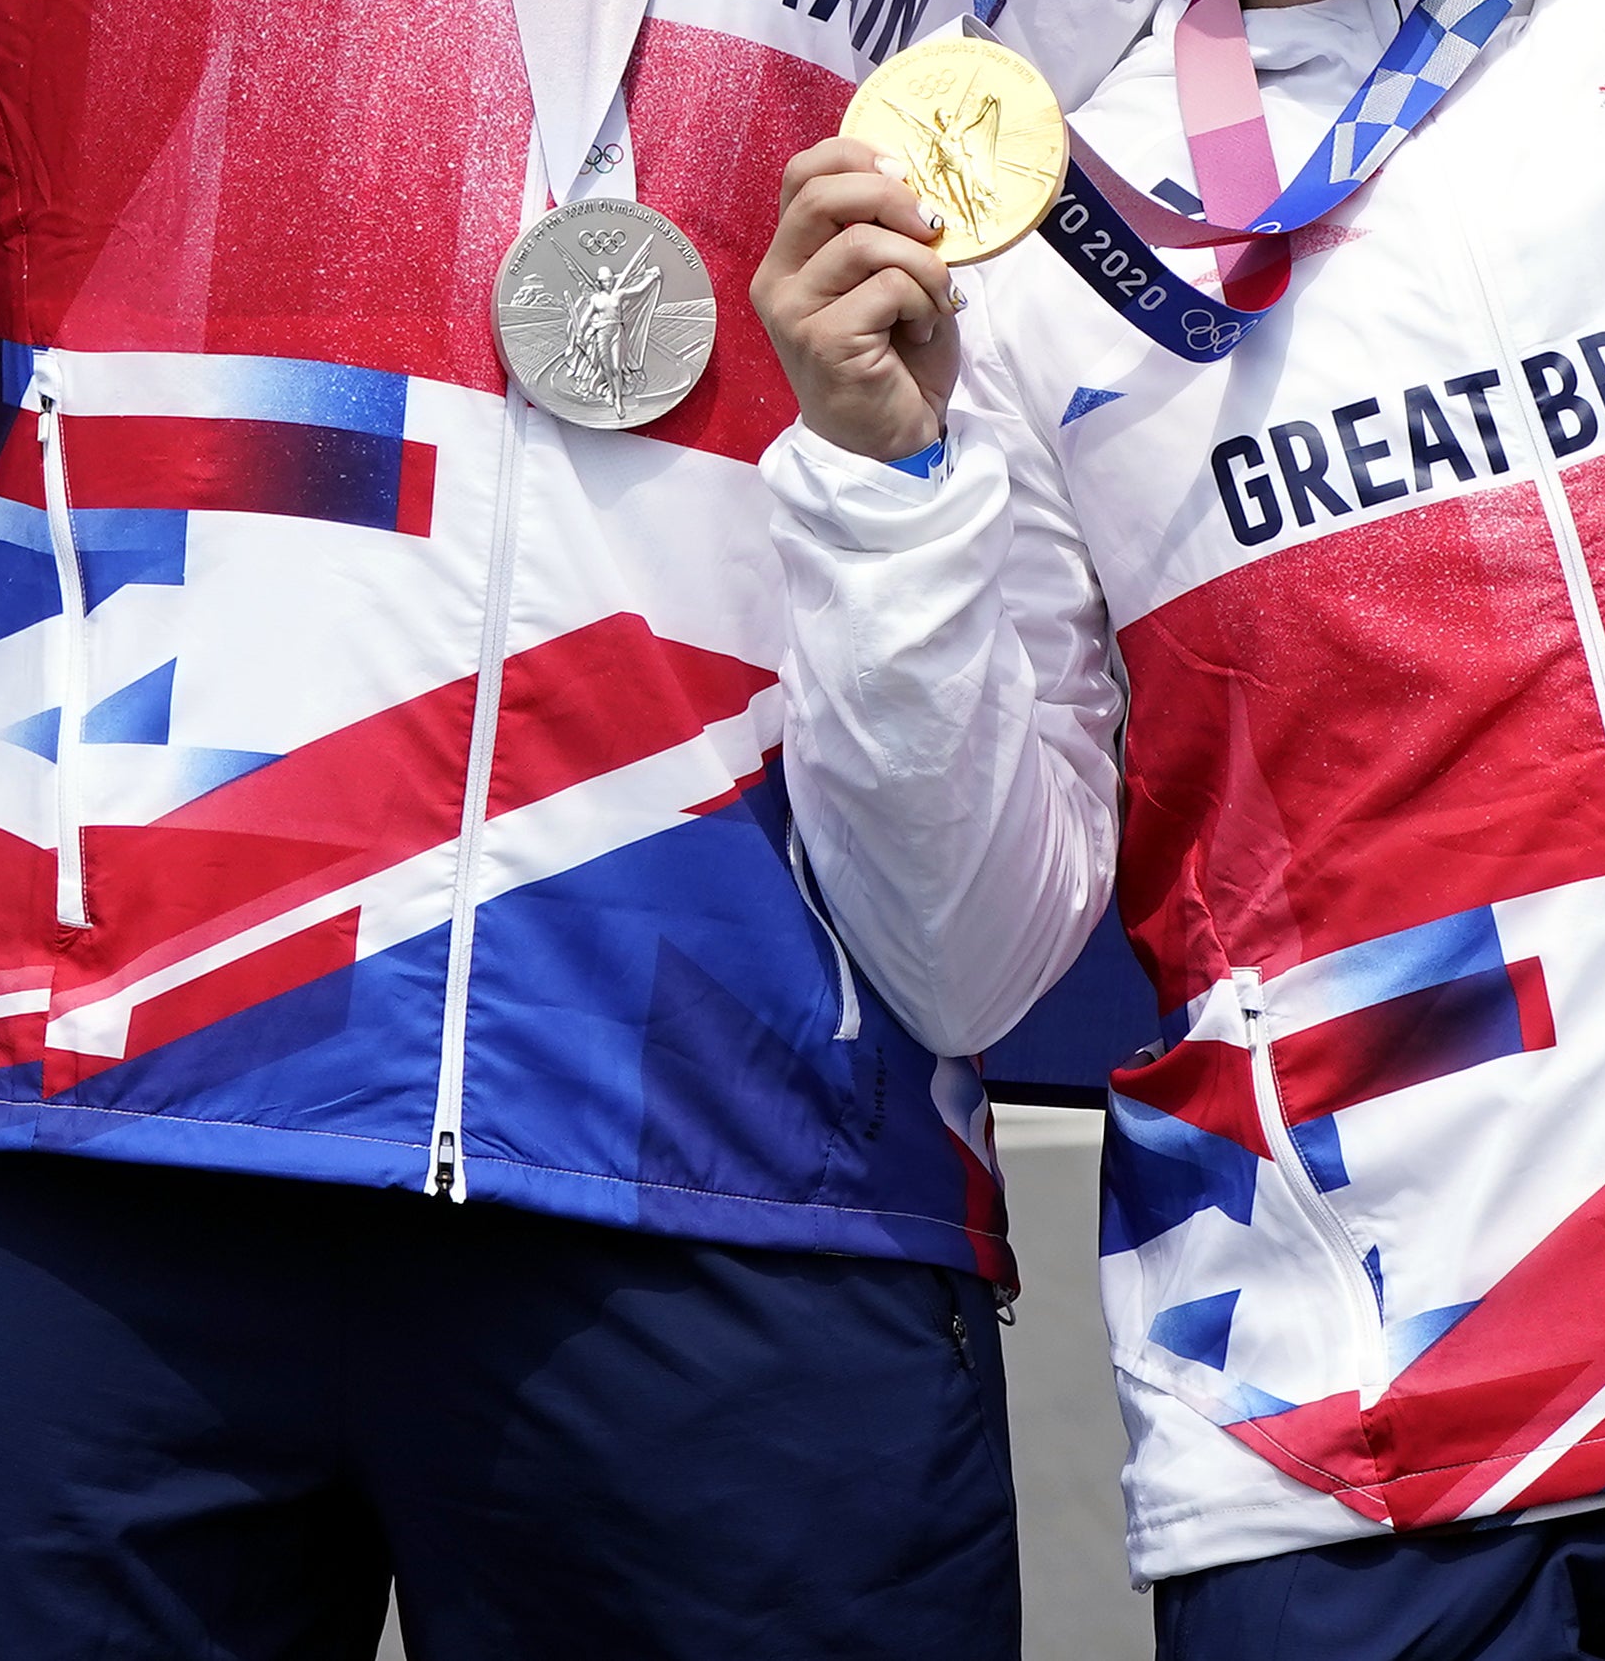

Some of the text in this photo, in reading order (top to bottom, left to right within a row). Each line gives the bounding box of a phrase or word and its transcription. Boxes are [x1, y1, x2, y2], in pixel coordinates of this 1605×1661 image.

[598, 200, 652, 223] Olympiad
[652, 216, 680, 244] Tokyo
[677, 241, 700, 270] 2020
[1080, 230, 1167, 311] 2020
[1211, 368, 1512, 547] GREAT
